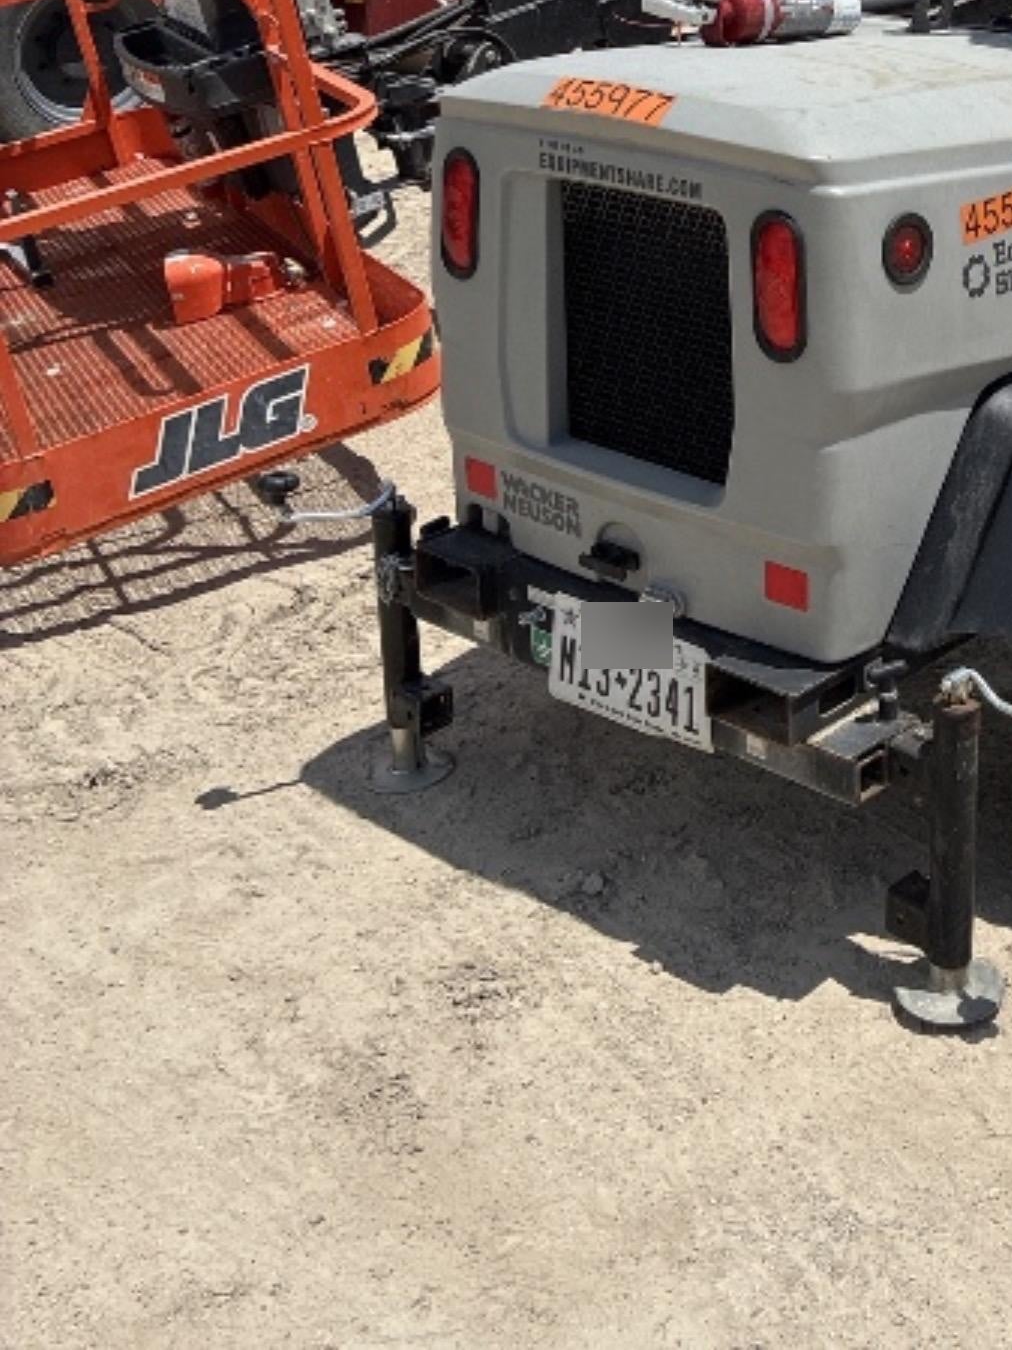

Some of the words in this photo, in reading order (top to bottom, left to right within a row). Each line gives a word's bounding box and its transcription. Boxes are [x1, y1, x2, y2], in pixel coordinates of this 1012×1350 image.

[550, 77, 676, 122] 455977
[538, 152, 704, 199] EQUIPMENTSHARE.COM
[128, 363, 311, 500] JLG
[501, 470, 580, 512] WACKER
[503, 493, 583, 538] NEUSON
